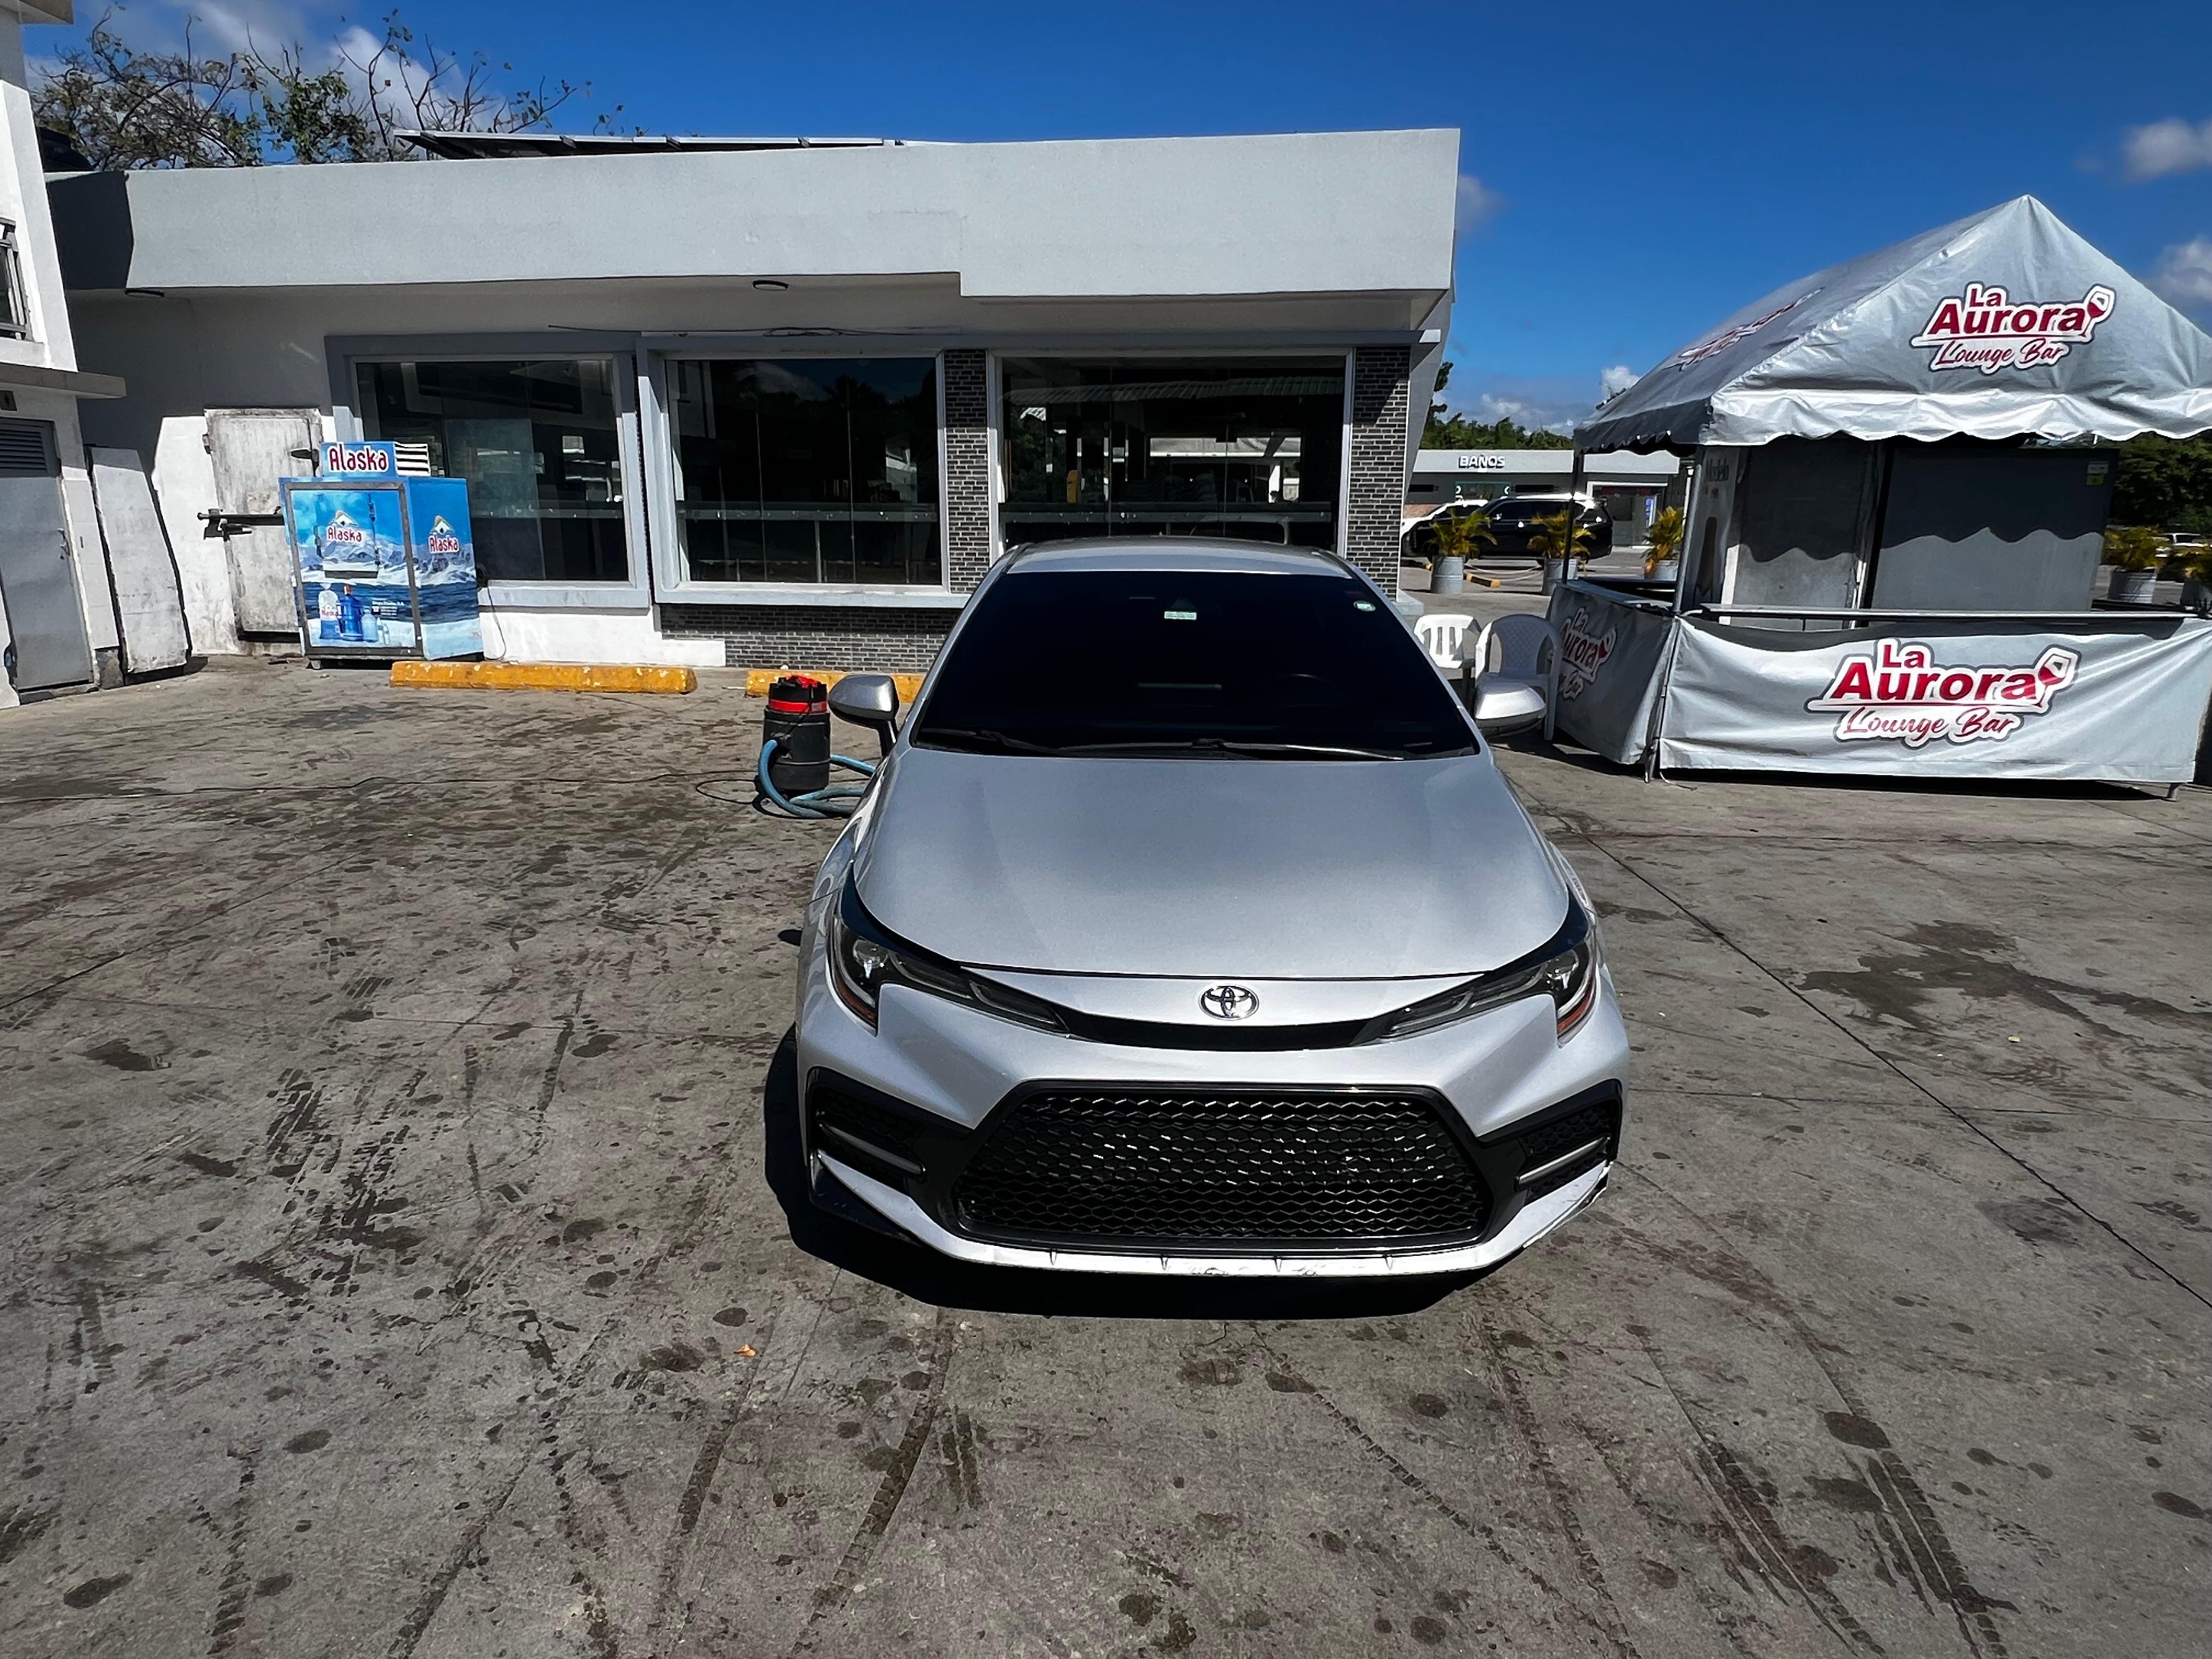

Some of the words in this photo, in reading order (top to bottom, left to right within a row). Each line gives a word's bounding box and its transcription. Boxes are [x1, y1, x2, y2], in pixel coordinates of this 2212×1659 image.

[1970, 287, 2002, 307] La
[1927, 303, 2086, 335] Aurora
[1936, 339, 2014, 370] Lounge
[2019, 338, 2064, 364] Bar
[329, 443, 388, 471] Alaska
[1458, 454, 1505, 469] BAÑOS
[328, 526, 362, 542] Alaska
[429, 534, 459, 552] Alaska
[1883, 644, 1925, 669] La
[1830, 662, 2038, 701] Aurora
[1843, 707, 1948, 741] Lounge
[1955, 707, 2014, 738] Bar
